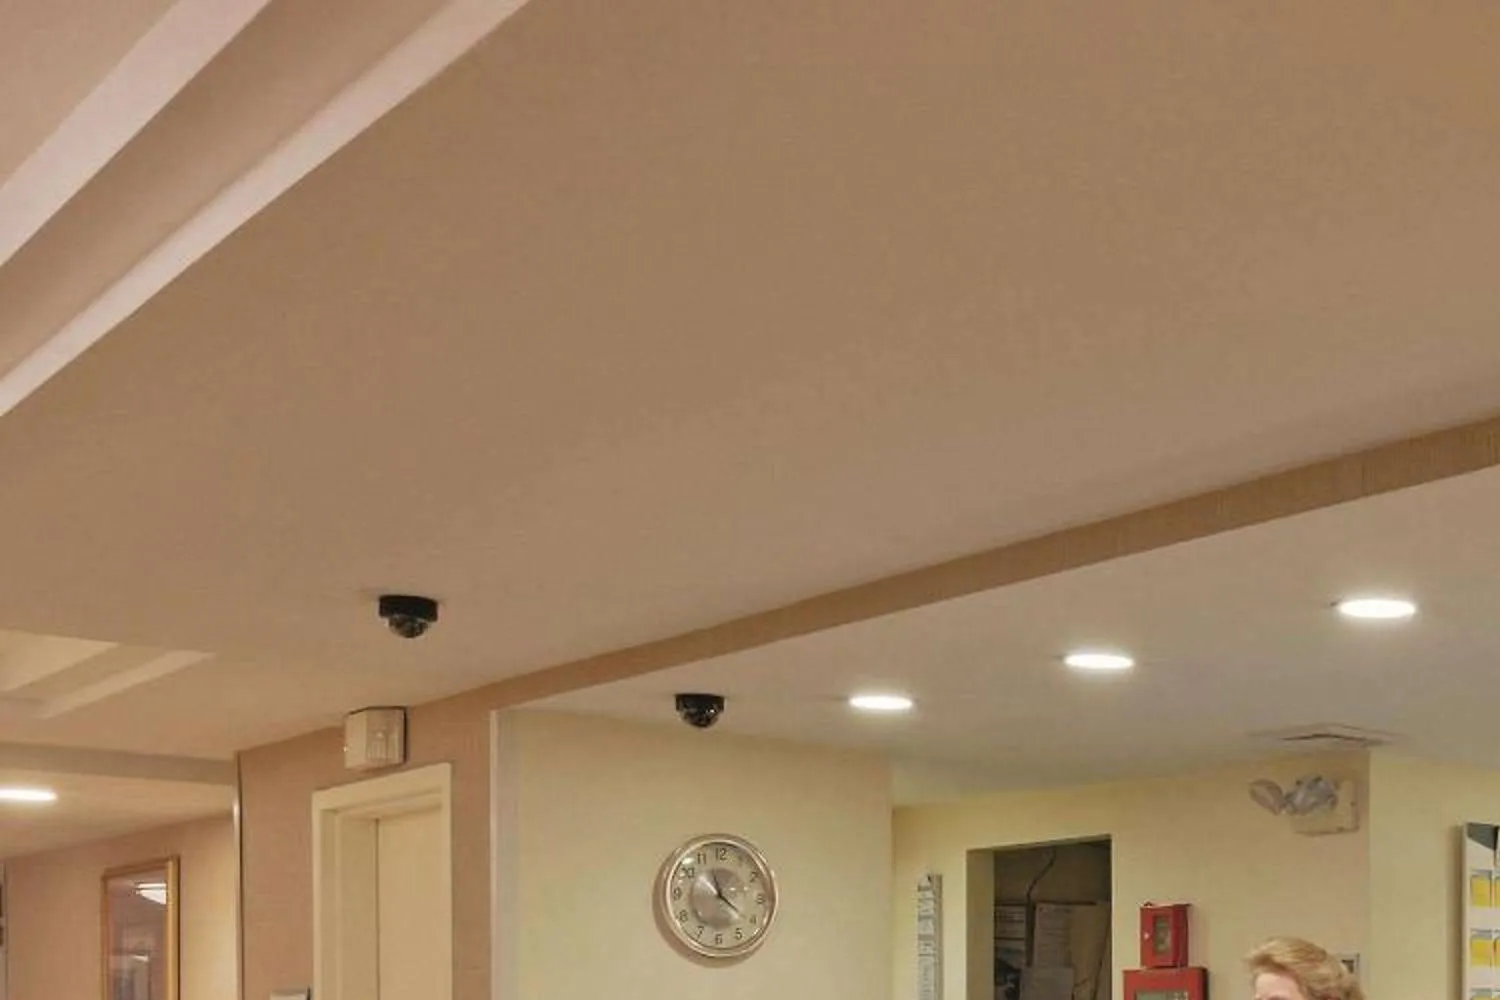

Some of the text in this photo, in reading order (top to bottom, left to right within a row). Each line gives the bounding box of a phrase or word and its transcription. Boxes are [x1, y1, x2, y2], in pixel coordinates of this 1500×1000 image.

[697, 852, 706, 865] 11
[715, 847, 727, 861] 12
[734, 927, 743, 940] 5
